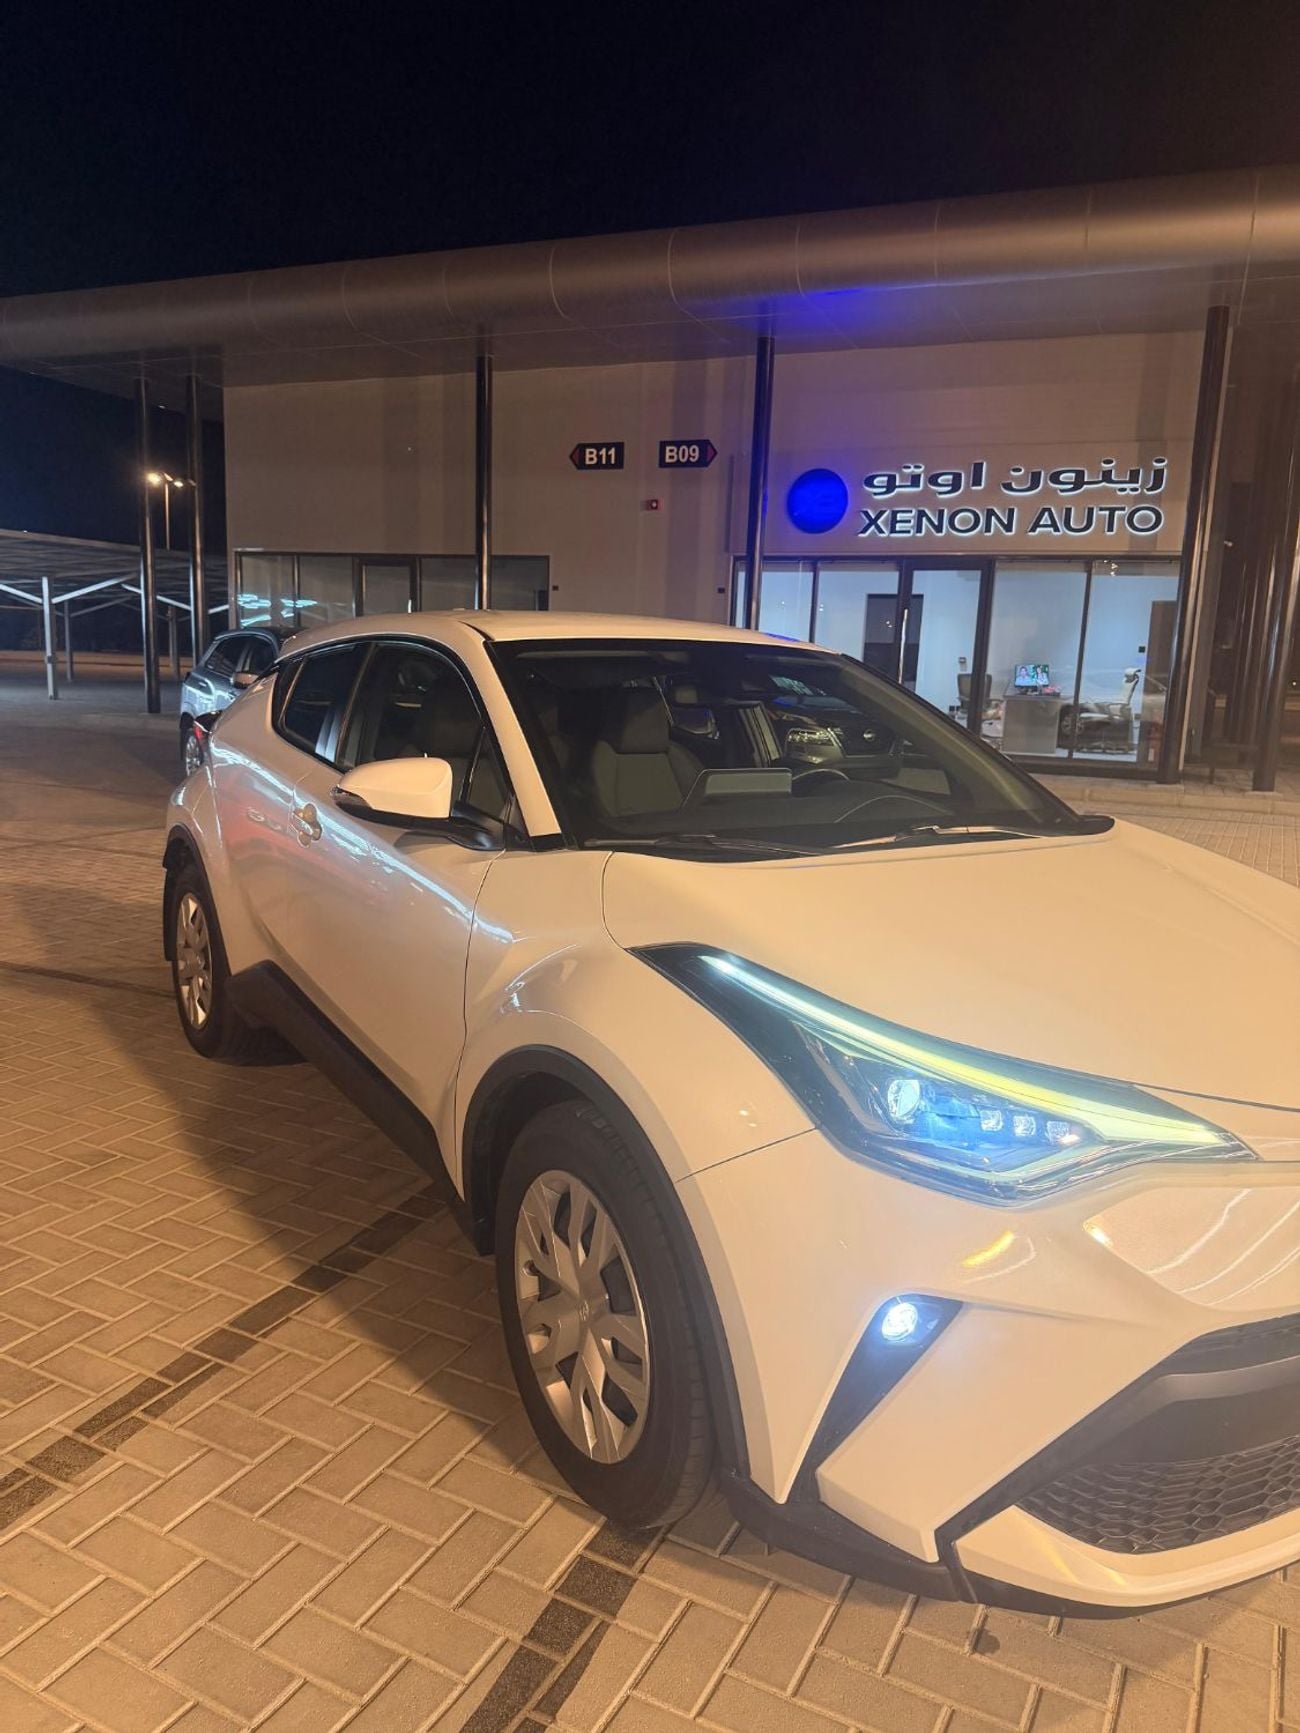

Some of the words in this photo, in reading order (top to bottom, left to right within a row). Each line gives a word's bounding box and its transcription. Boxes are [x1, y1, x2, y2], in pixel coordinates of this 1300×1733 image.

[585, 448, 616, 465] B11
[665, 445, 699, 463] B09
[863, 460, 986, 499] اوتو
[1000, 457, 1168, 496] زينون
[858, 506, 1017, 537] XENON
[1028, 504, 1165, 535] AUTO
